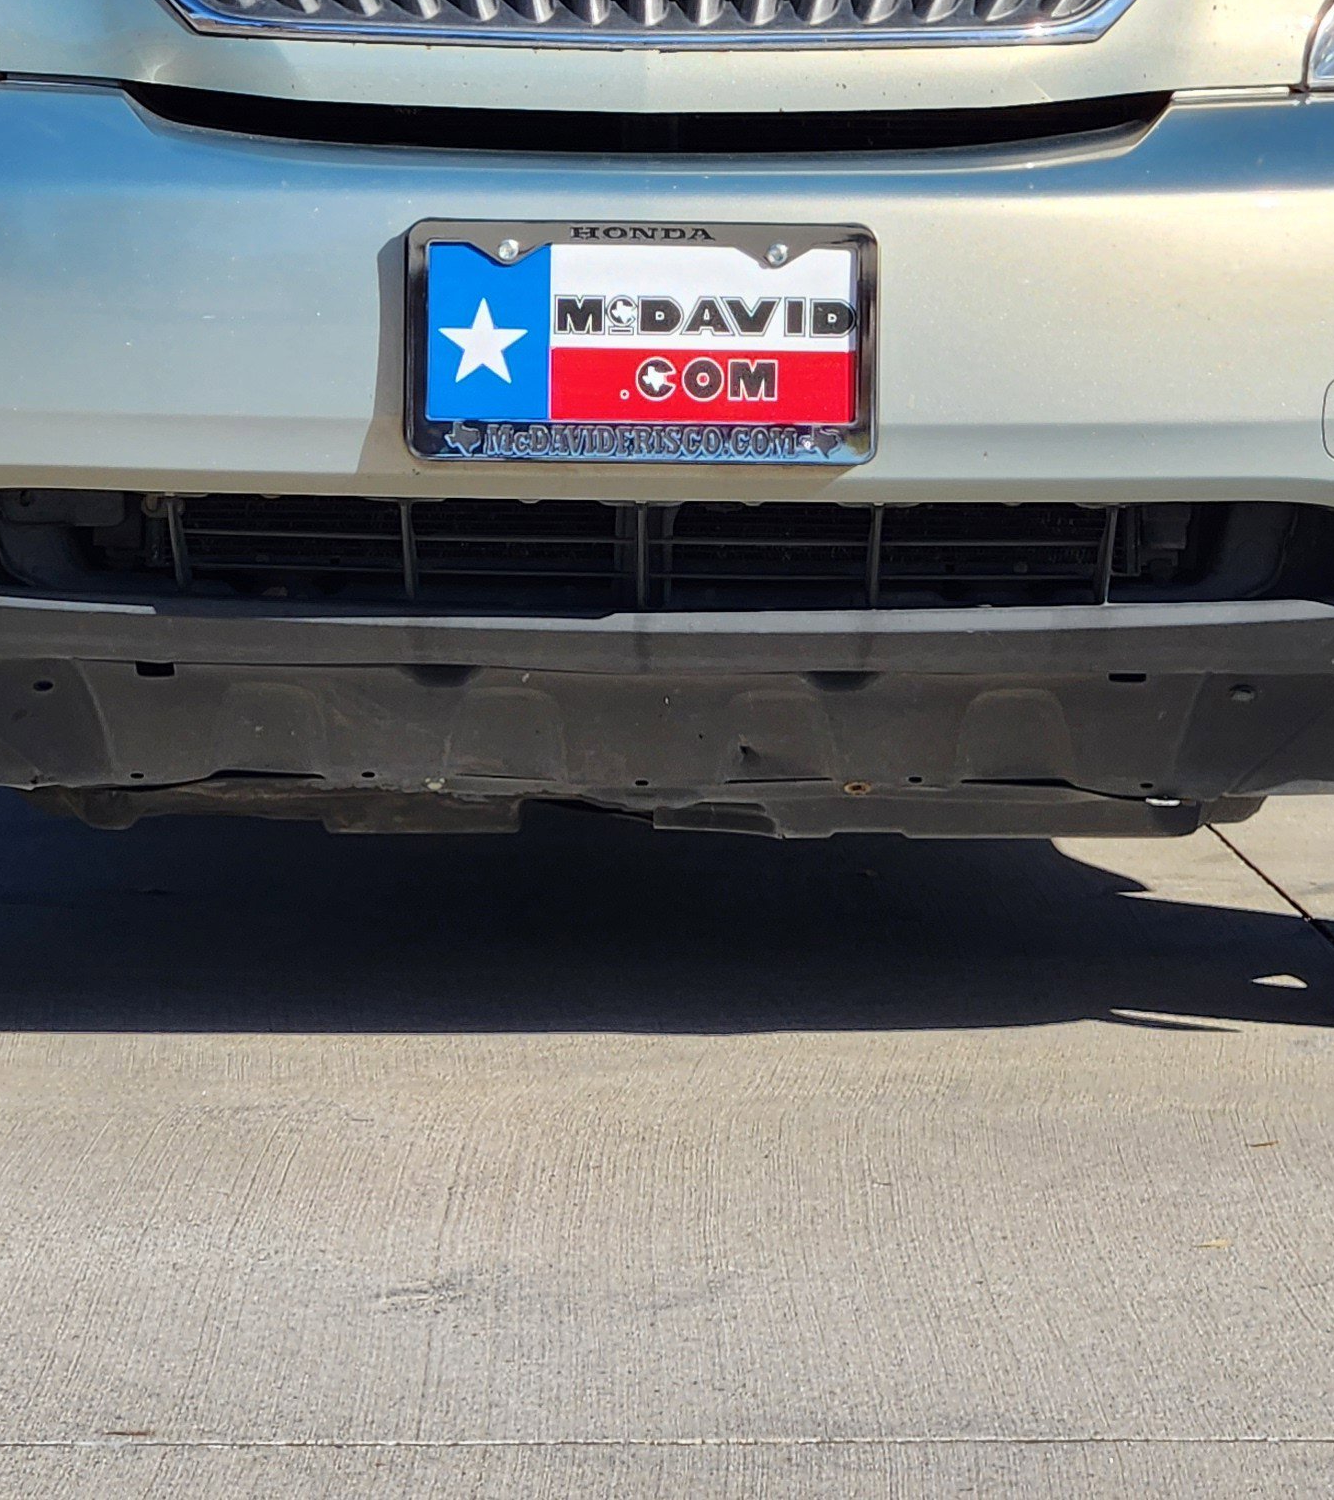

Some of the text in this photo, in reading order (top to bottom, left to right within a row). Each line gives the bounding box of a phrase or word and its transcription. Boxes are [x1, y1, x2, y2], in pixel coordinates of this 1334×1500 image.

[569, 226, 716, 241] HONDA
[619, 356, 779, 402] .COM
[483, 423, 799, 457] McDAVIDFRISCO.COM
